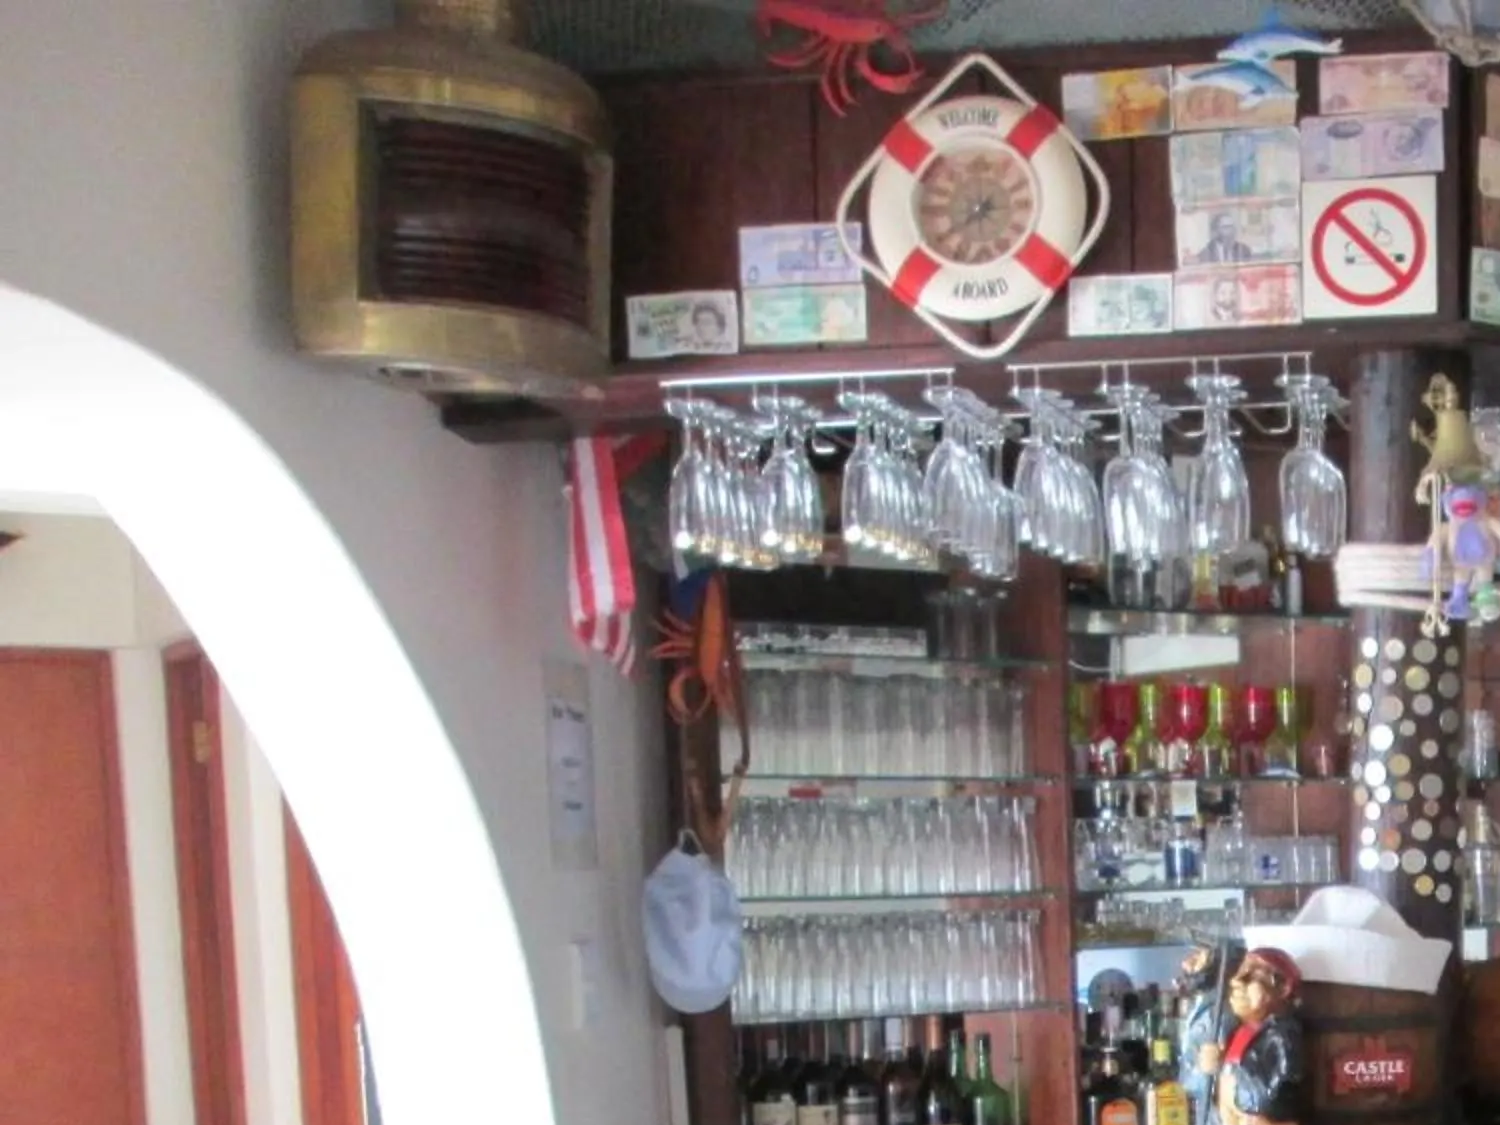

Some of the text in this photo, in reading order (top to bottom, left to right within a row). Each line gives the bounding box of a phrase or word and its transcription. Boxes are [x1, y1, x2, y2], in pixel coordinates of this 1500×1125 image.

[938, 106, 998, 130] WELCOME
[953, 277, 1008, 299] ABOARD
[1343, 1060, 1404, 1074] CASTLE
